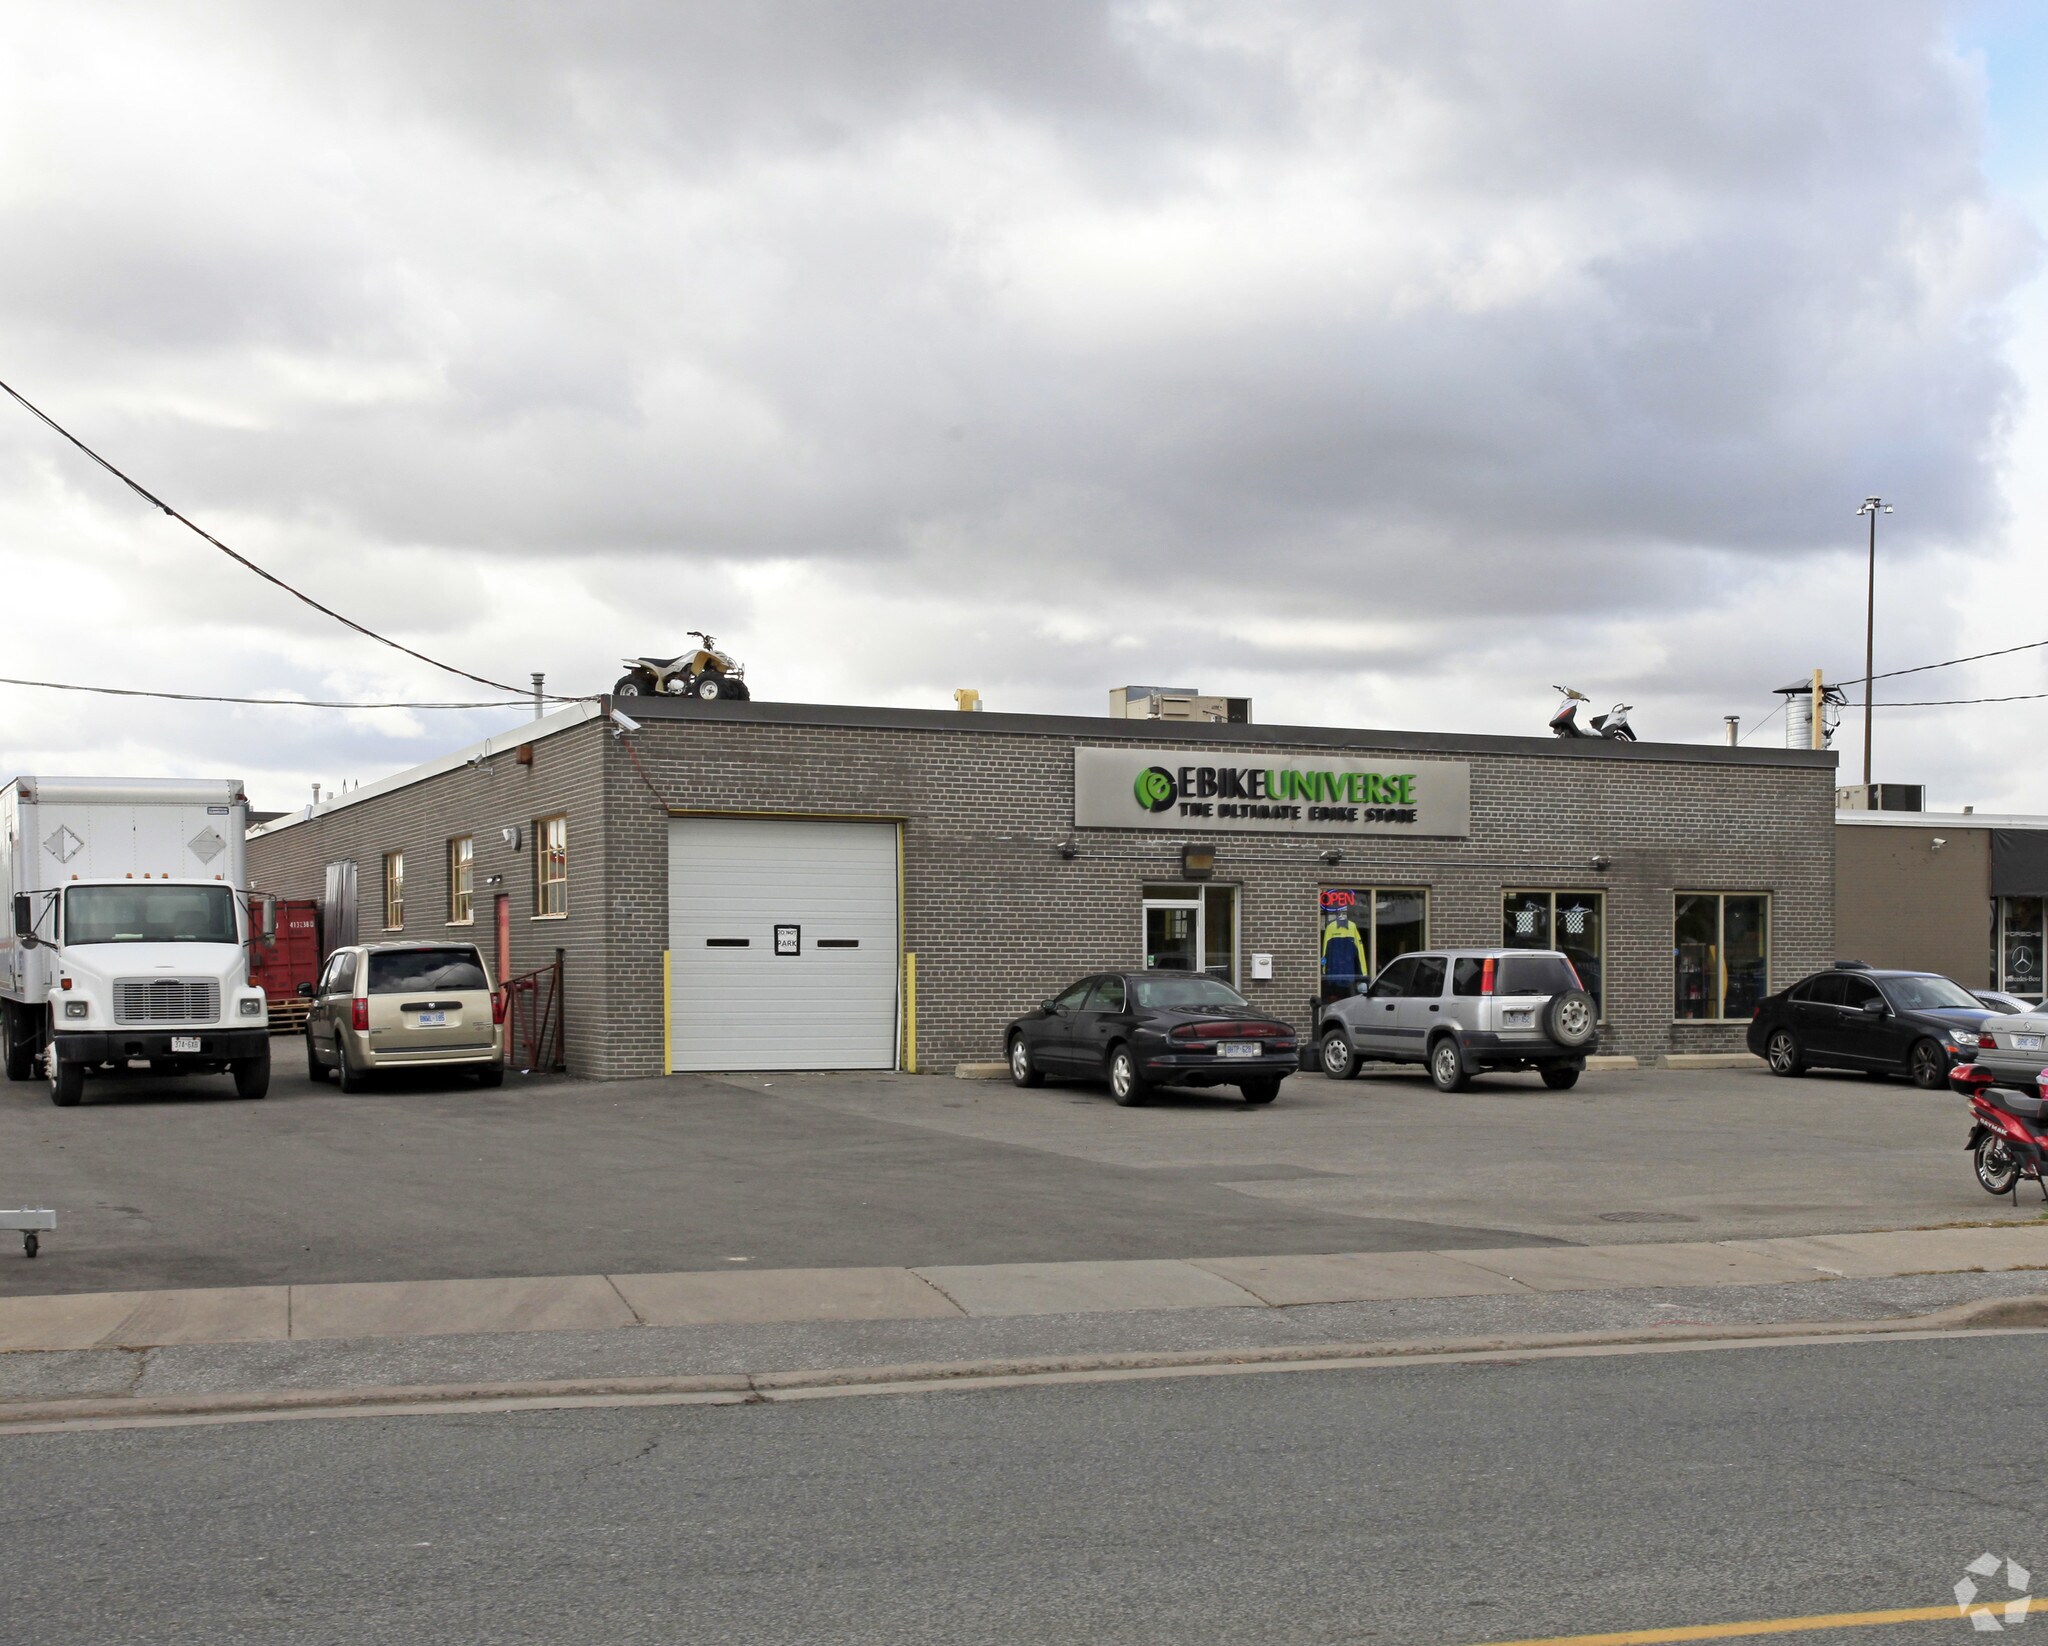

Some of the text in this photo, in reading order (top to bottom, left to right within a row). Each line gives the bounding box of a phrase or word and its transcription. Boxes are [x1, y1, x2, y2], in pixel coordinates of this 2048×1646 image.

[1178, 802, 1418, 823] THE ULTIMATE EBIKE STORE
[1320, 892, 1355, 906] OPEN
[1980, 1118, 2008, 1136] DAYMAK
